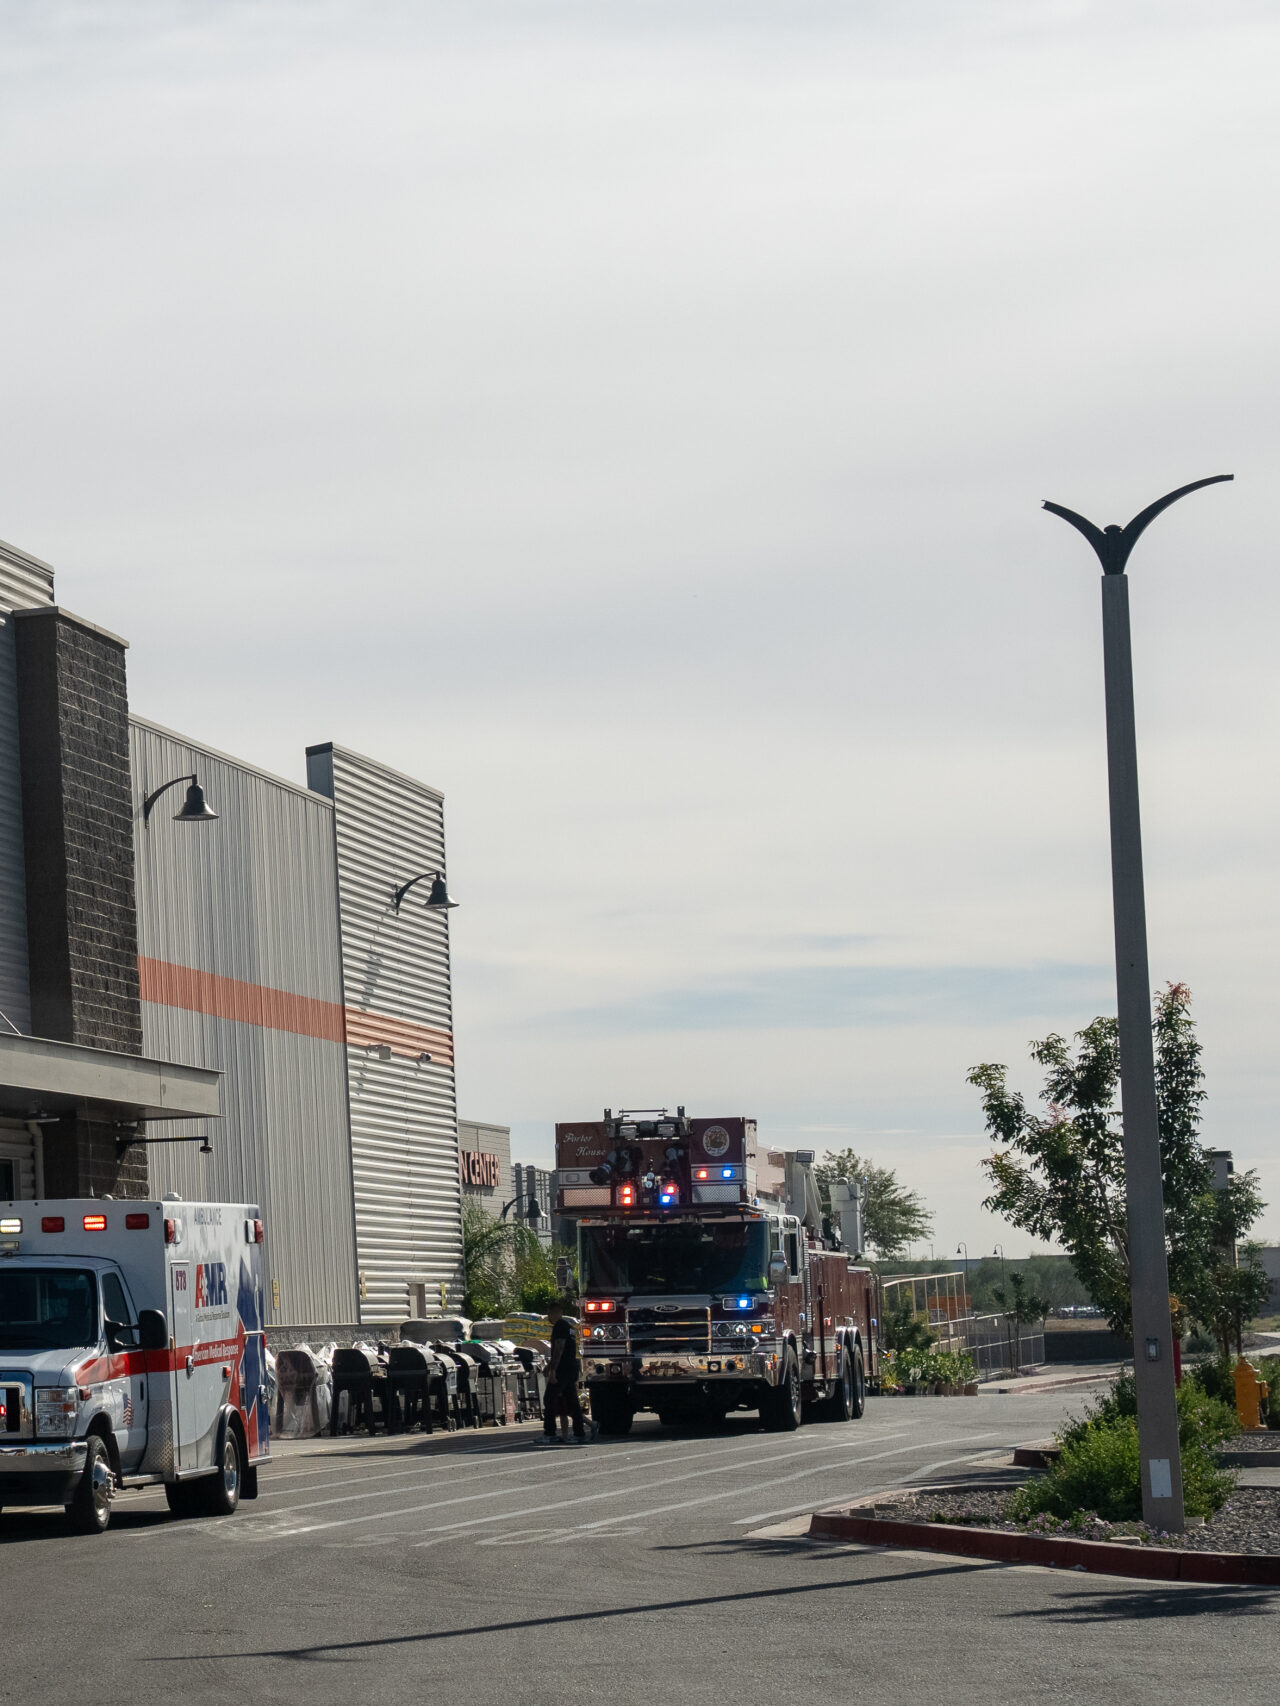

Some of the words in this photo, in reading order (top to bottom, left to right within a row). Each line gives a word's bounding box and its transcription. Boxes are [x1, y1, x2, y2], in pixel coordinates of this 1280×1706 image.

[562, 1133, 593, 1143] Porter
[575, 1146, 606, 1157] House
[469, 1151, 500, 1187] CENTER
[194, 1207, 222, 1226] AMBULANCE
[195, 1262, 228, 1308] AMR
[208, 1343, 222, 1358] Medical
[222, 1343, 239, 1359] Response
